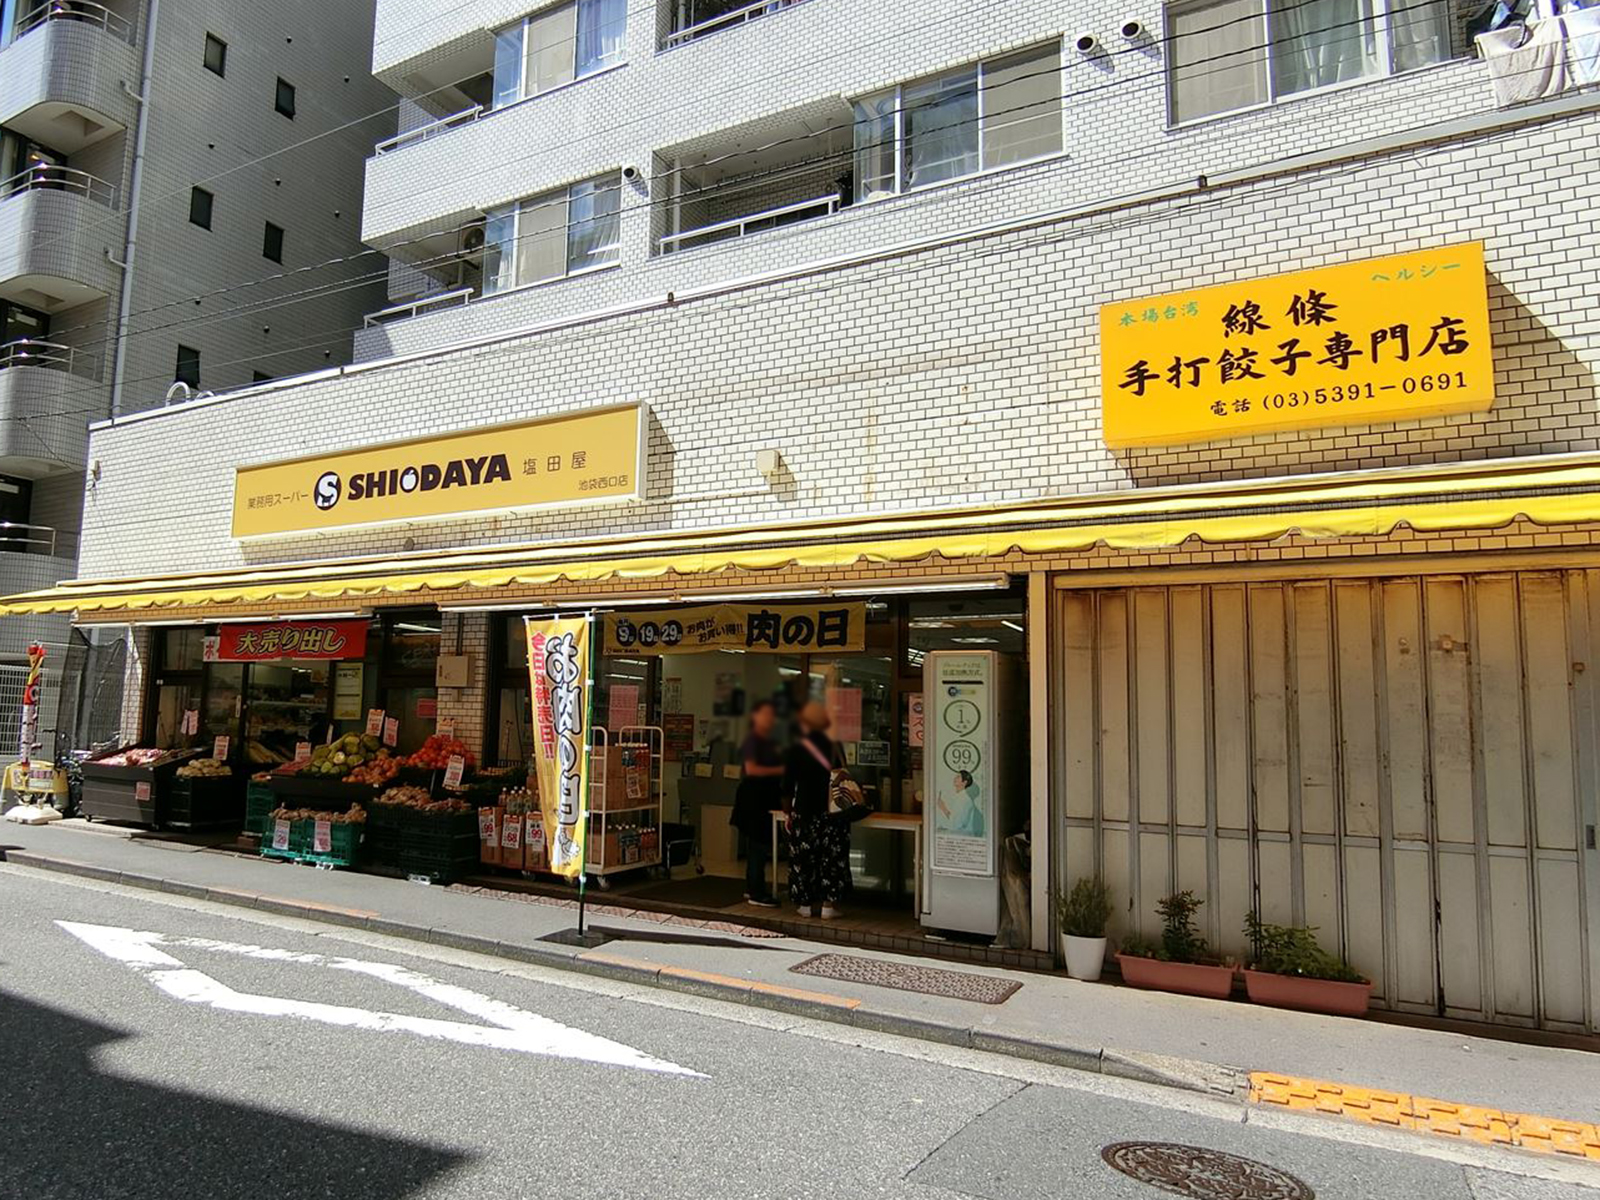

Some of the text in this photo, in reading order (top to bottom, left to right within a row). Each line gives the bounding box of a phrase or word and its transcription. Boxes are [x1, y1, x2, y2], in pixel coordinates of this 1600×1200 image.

[1371, 261, 1461, 283] ヘルシー
[1118, 300, 1199, 327] 本場台湾
[1221, 288, 1338, 338] 線條
[1118, 316, 1470, 397] 手打餃子専門店
[1210, 398, 1251, 417] 電話
[247, 491, 309, 510] 業務用スーパー
[347, 453, 512, 501] SHIODAYA
[522, 450, 588, 476] 塩田屋
[578, 475, 629, 491] 池袋西口店
[686, 617, 717, 635] お肉が
[745, 608, 849, 648] 肉の日
[236, 626, 347, 655] 大売り出し
